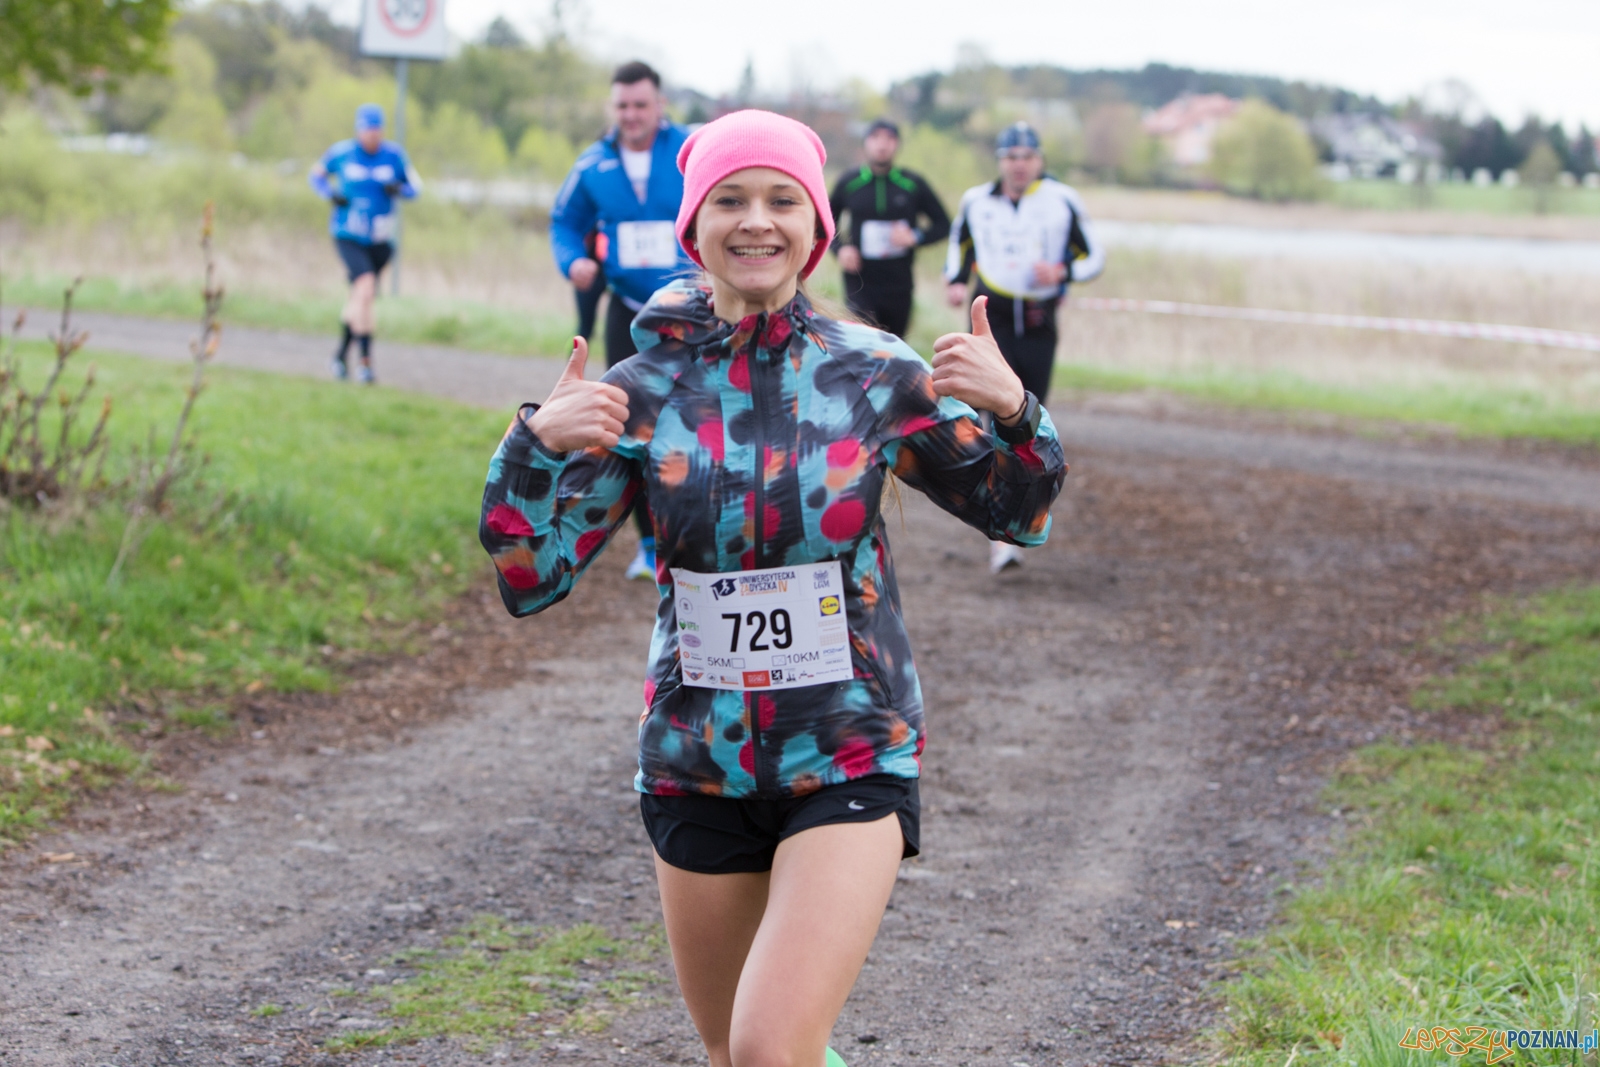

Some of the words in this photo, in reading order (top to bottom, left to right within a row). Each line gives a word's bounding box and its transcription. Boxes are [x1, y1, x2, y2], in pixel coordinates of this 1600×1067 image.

[739, 571, 796, 584] UNIWERSYTECKA
[740, 581, 778, 593] ZADYSZKA
[778, 580, 788, 593] IV
[721, 608, 793, 652] 729
[707, 656, 731, 668] 5KM
[787, 651, 820, 664] 10KM
